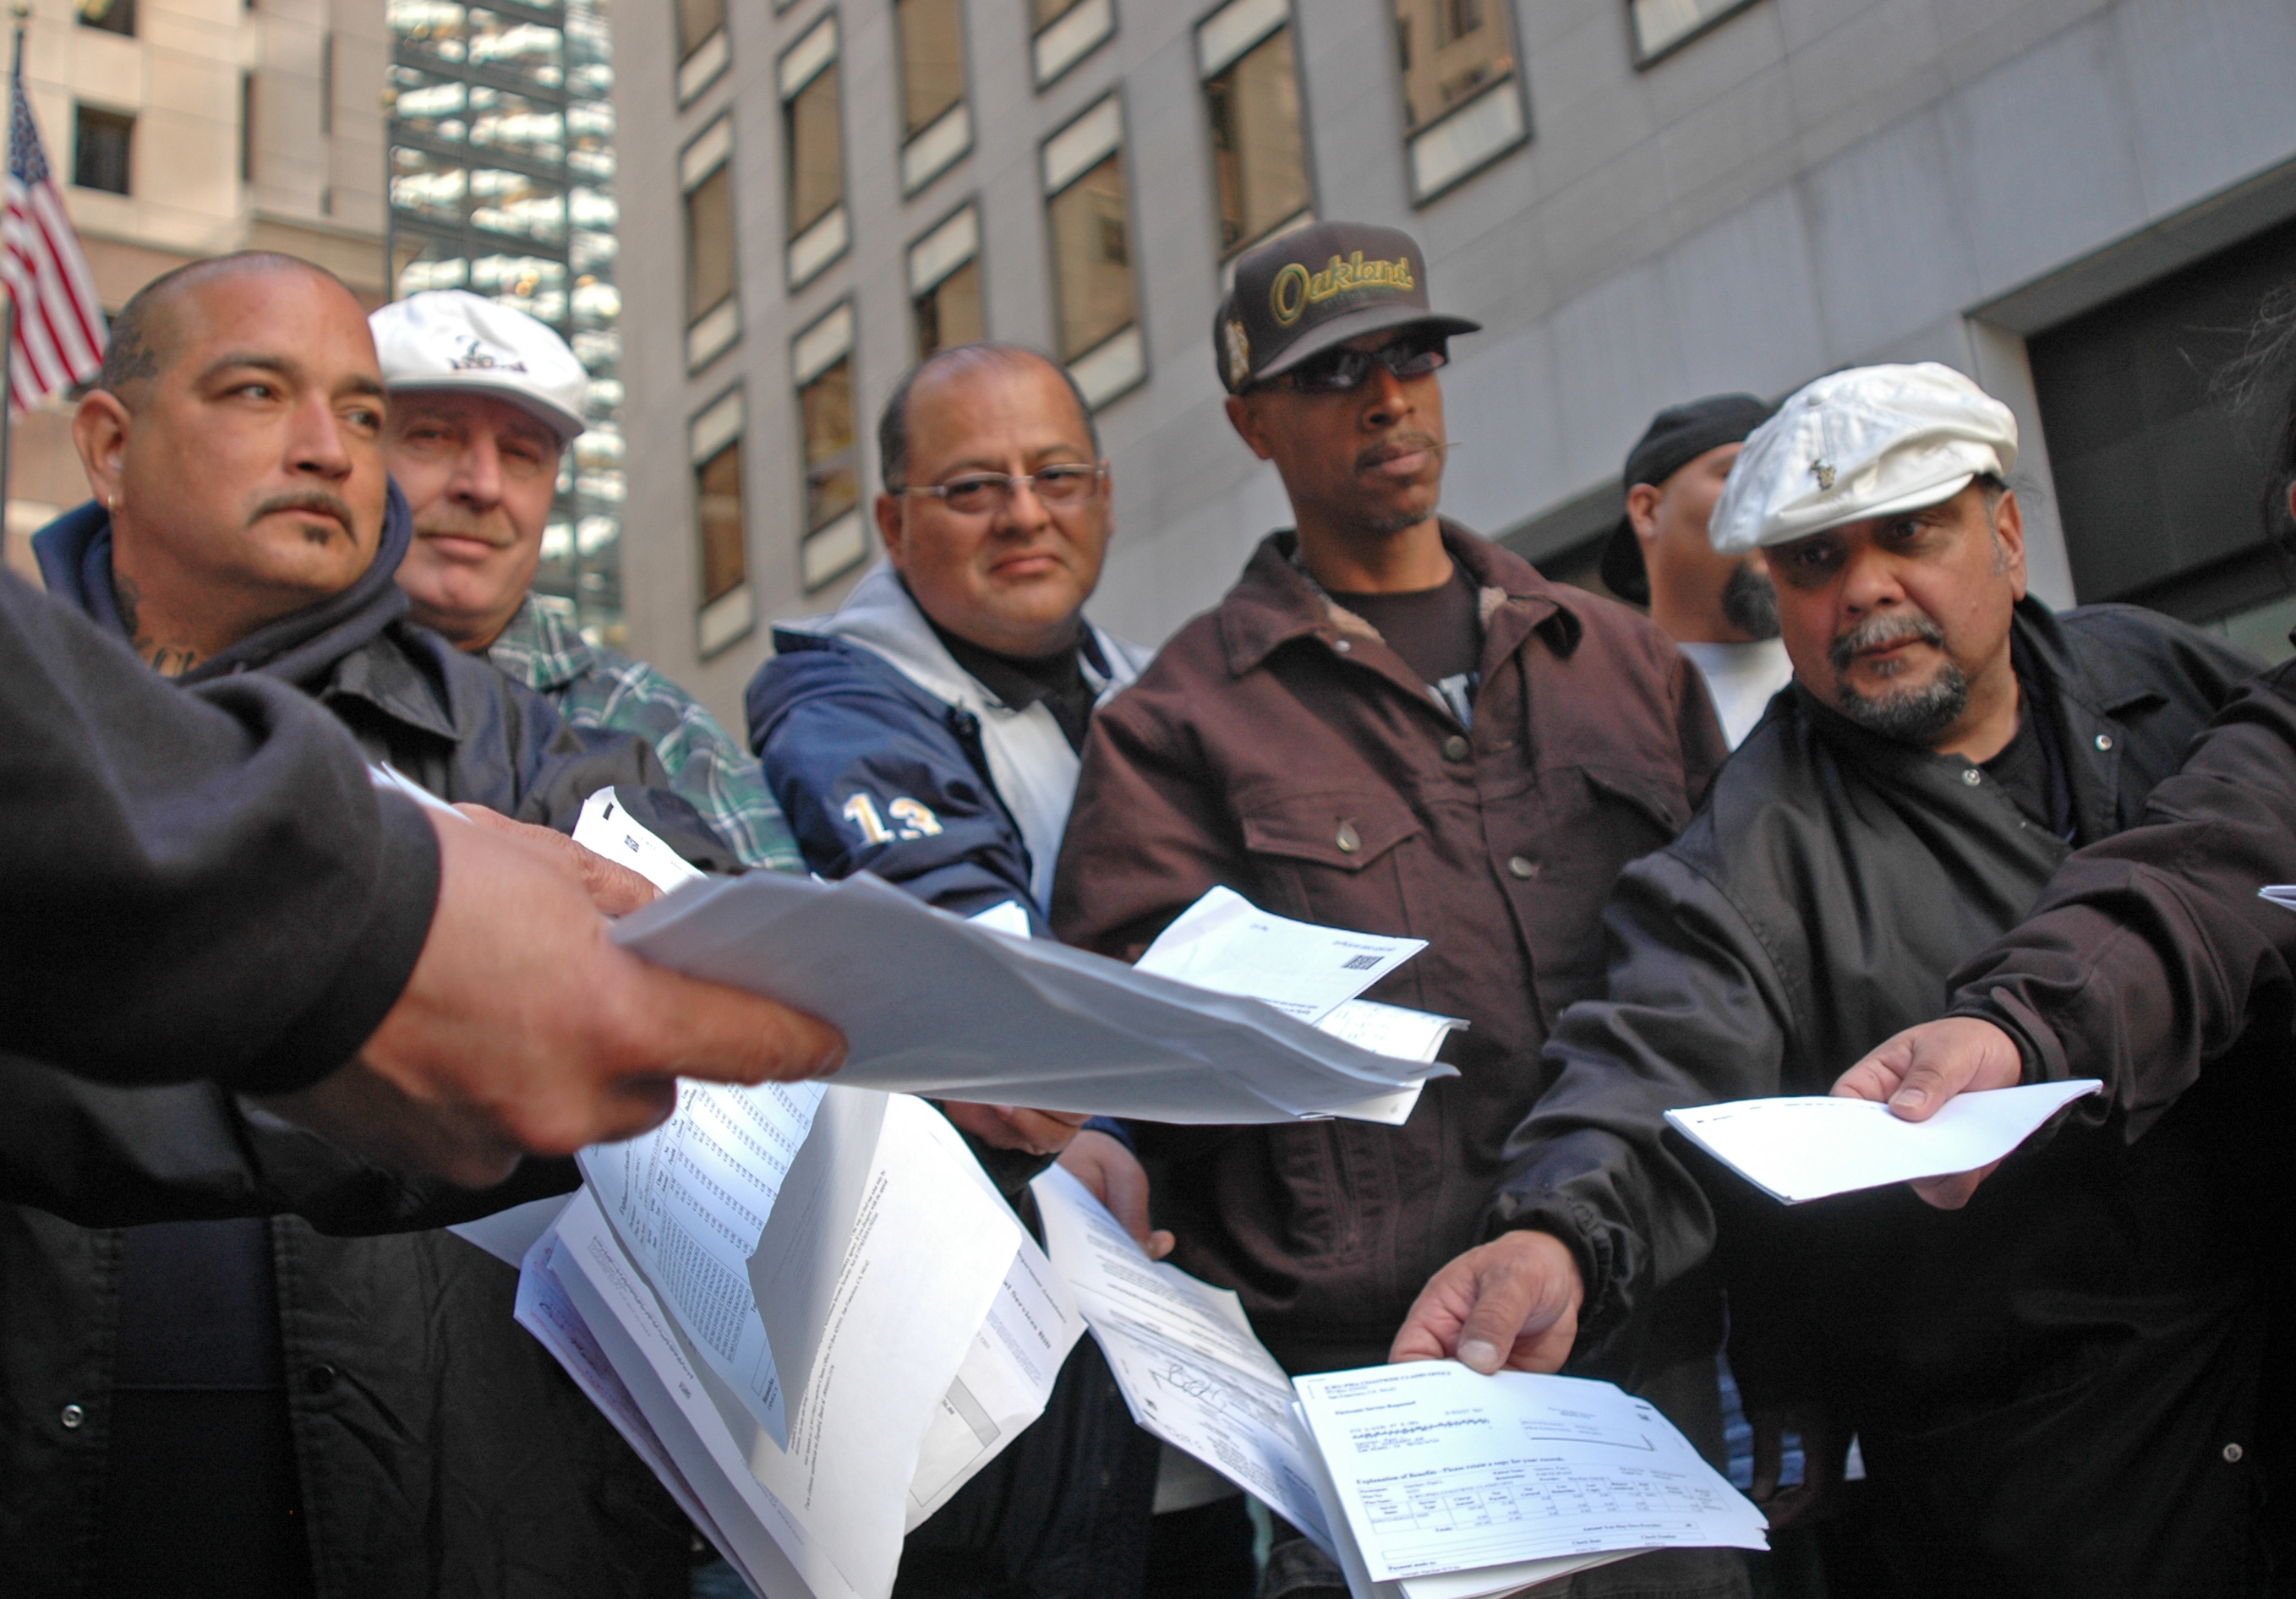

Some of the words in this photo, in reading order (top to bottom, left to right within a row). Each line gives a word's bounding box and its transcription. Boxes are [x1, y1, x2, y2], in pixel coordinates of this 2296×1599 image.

[1271, 249, 1414, 327] Oakland
[1010, 1290, 1038, 1330] Services
[1356, 1474, 1398, 1485] Explanation
[1408, 1470, 1436, 1479] Benefits
[1442, 1465, 1465, 1473] Please
[1494, 1460, 1510, 1468] copy
